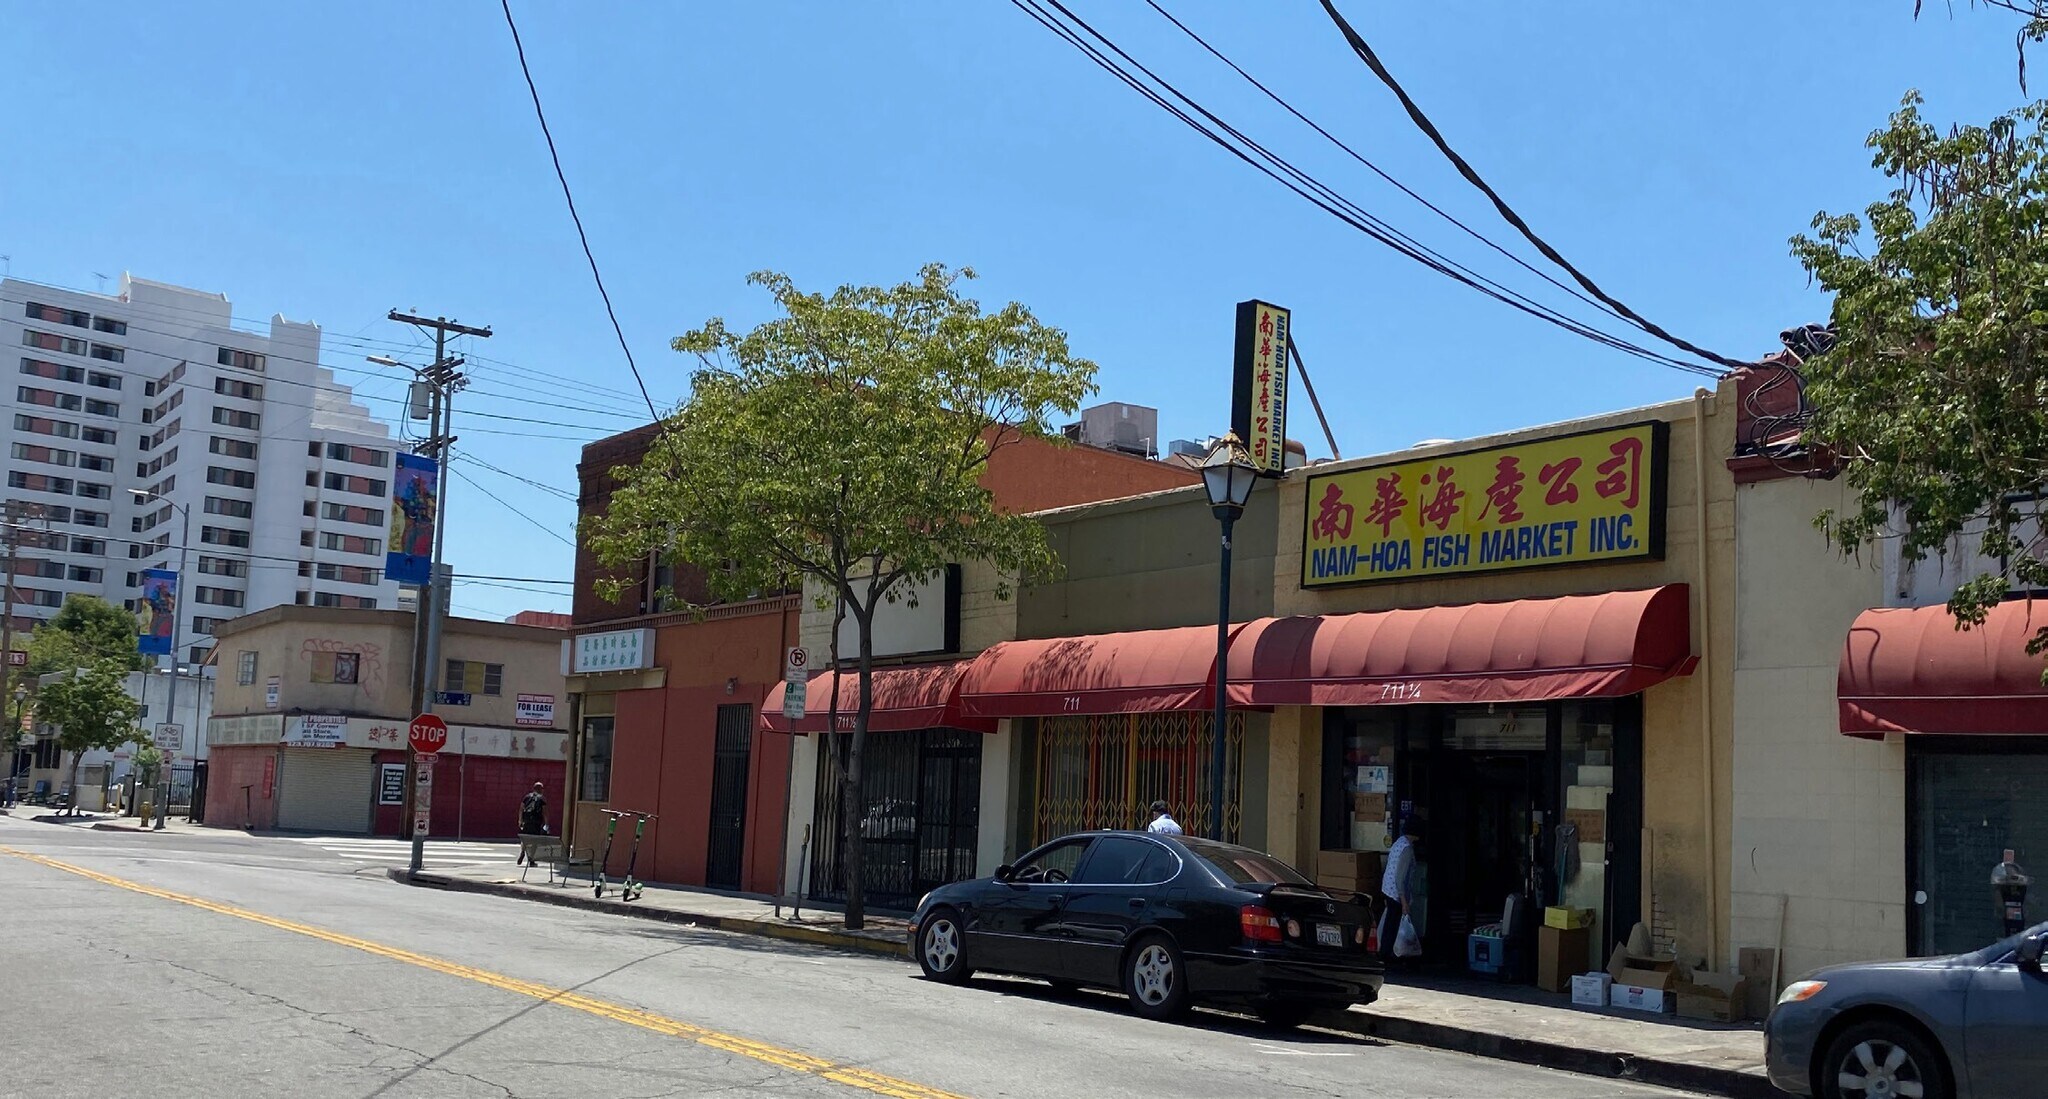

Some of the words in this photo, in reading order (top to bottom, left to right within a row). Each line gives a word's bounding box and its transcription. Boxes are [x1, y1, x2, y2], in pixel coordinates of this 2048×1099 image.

[1274, 314, 1286, 369] NAM-HOA
[1273, 370, 1284, 397] FISH
[1273, 400, 1283, 447] MARKET
[1311, 540, 1412, 579] NAM-HOA
[1422, 533, 1471, 570] FISH
[1480, 520, 1579, 565] MARKET
[1590, 513, 1640, 552] INC.
[517, 702, 531, 711] FOR
[532, 704, 553, 713] LEASE
[1063, 696, 1080, 711] 711
[410, 724, 446, 743] STOP
[1375, 767, 1385, 781] A
[1400, 800, 1413, 811] EBT
